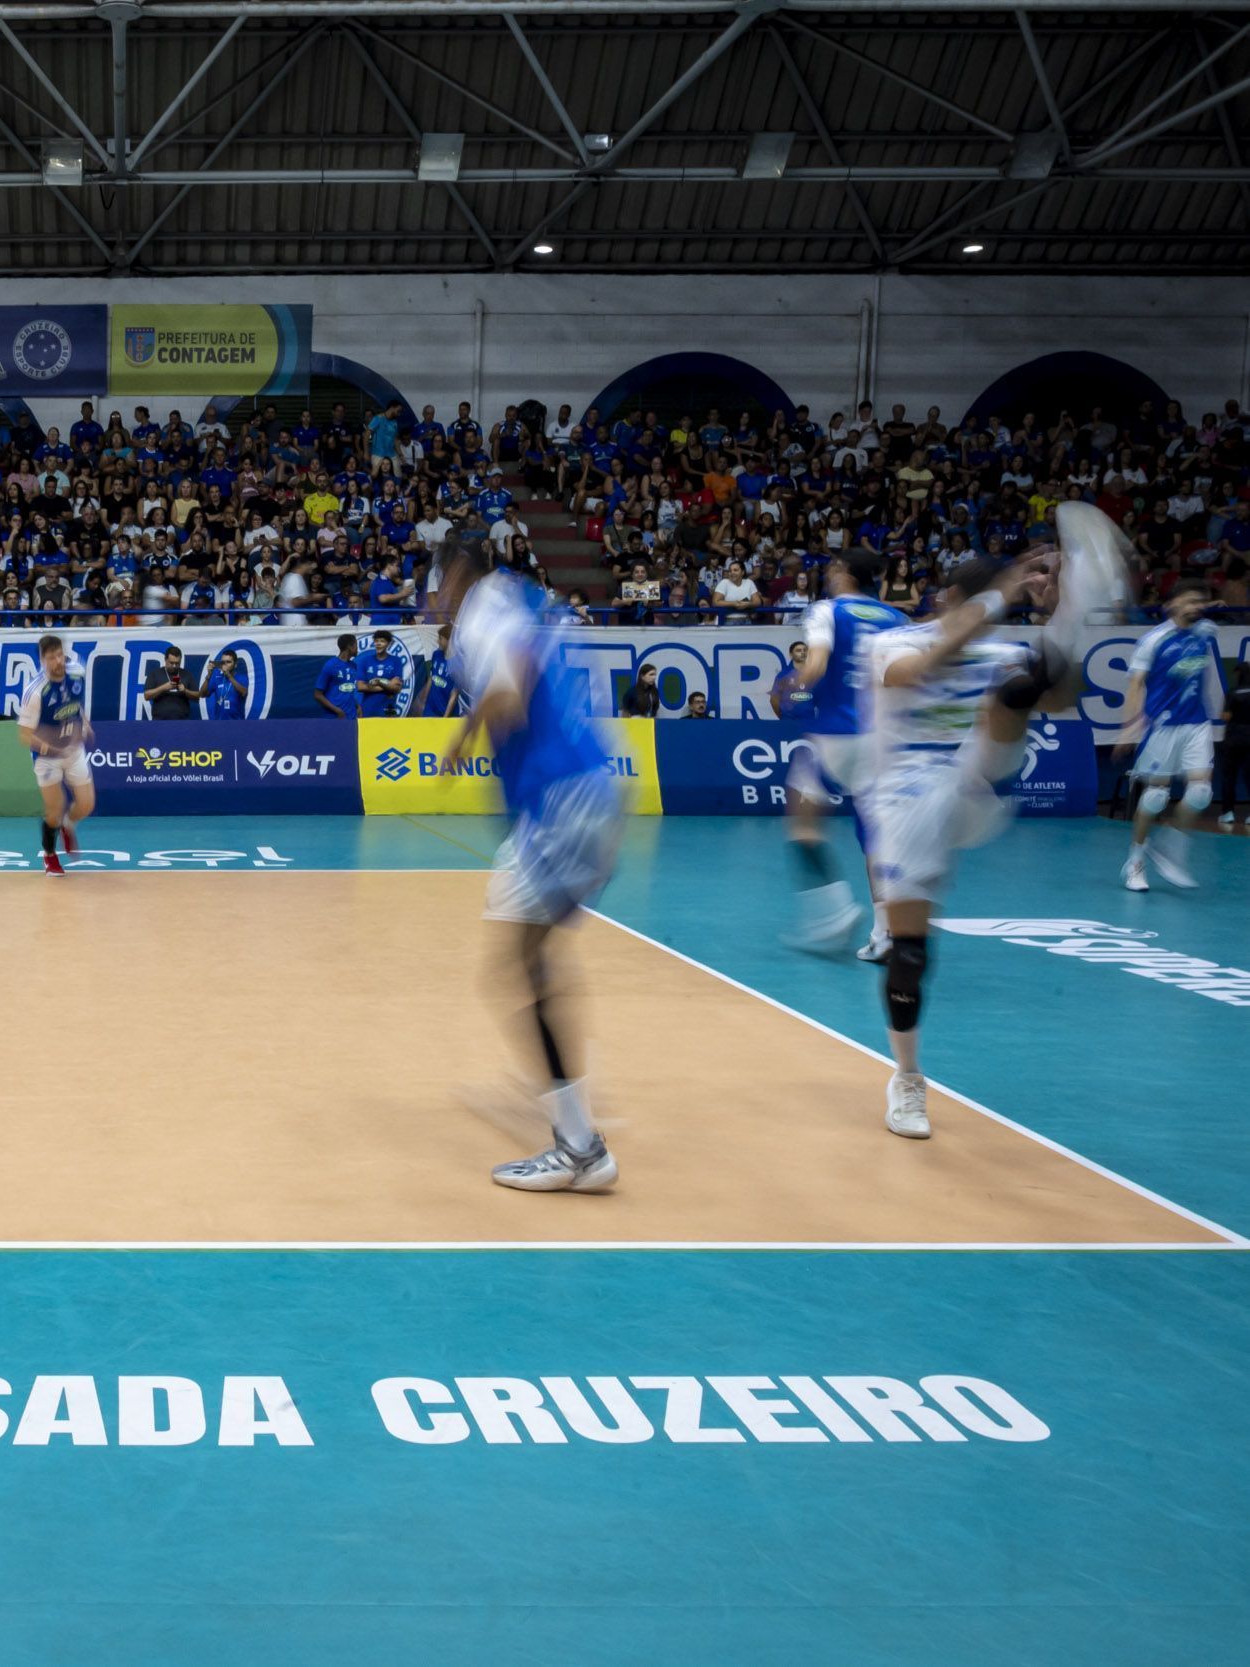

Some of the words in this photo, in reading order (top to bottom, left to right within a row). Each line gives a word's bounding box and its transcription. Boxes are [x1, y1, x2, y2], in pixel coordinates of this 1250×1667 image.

[20, 321, 66, 340] CRUZEIRO
[157, 332, 236, 345] PREFEITURA
[239, 332, 256, 345] DE
[15, 345, 47, 377] ESPORTE
[51, 345, 69, 374] CLUBE
[157, 346, 256, 364] CONTAGEM
[168, 751, 223, 767] SHOP
[247, 750, 335, 779] VOLT
[133, 774, 147, 783] loja
[148, 774, 170, 782] oficial
[172, 774, 181, 782] do
[183, 774, 201, 782] Vôlei
[203, 774, 224, 782] Brasil
[371, 1375, 1050, 1444] CRUZEIRO
